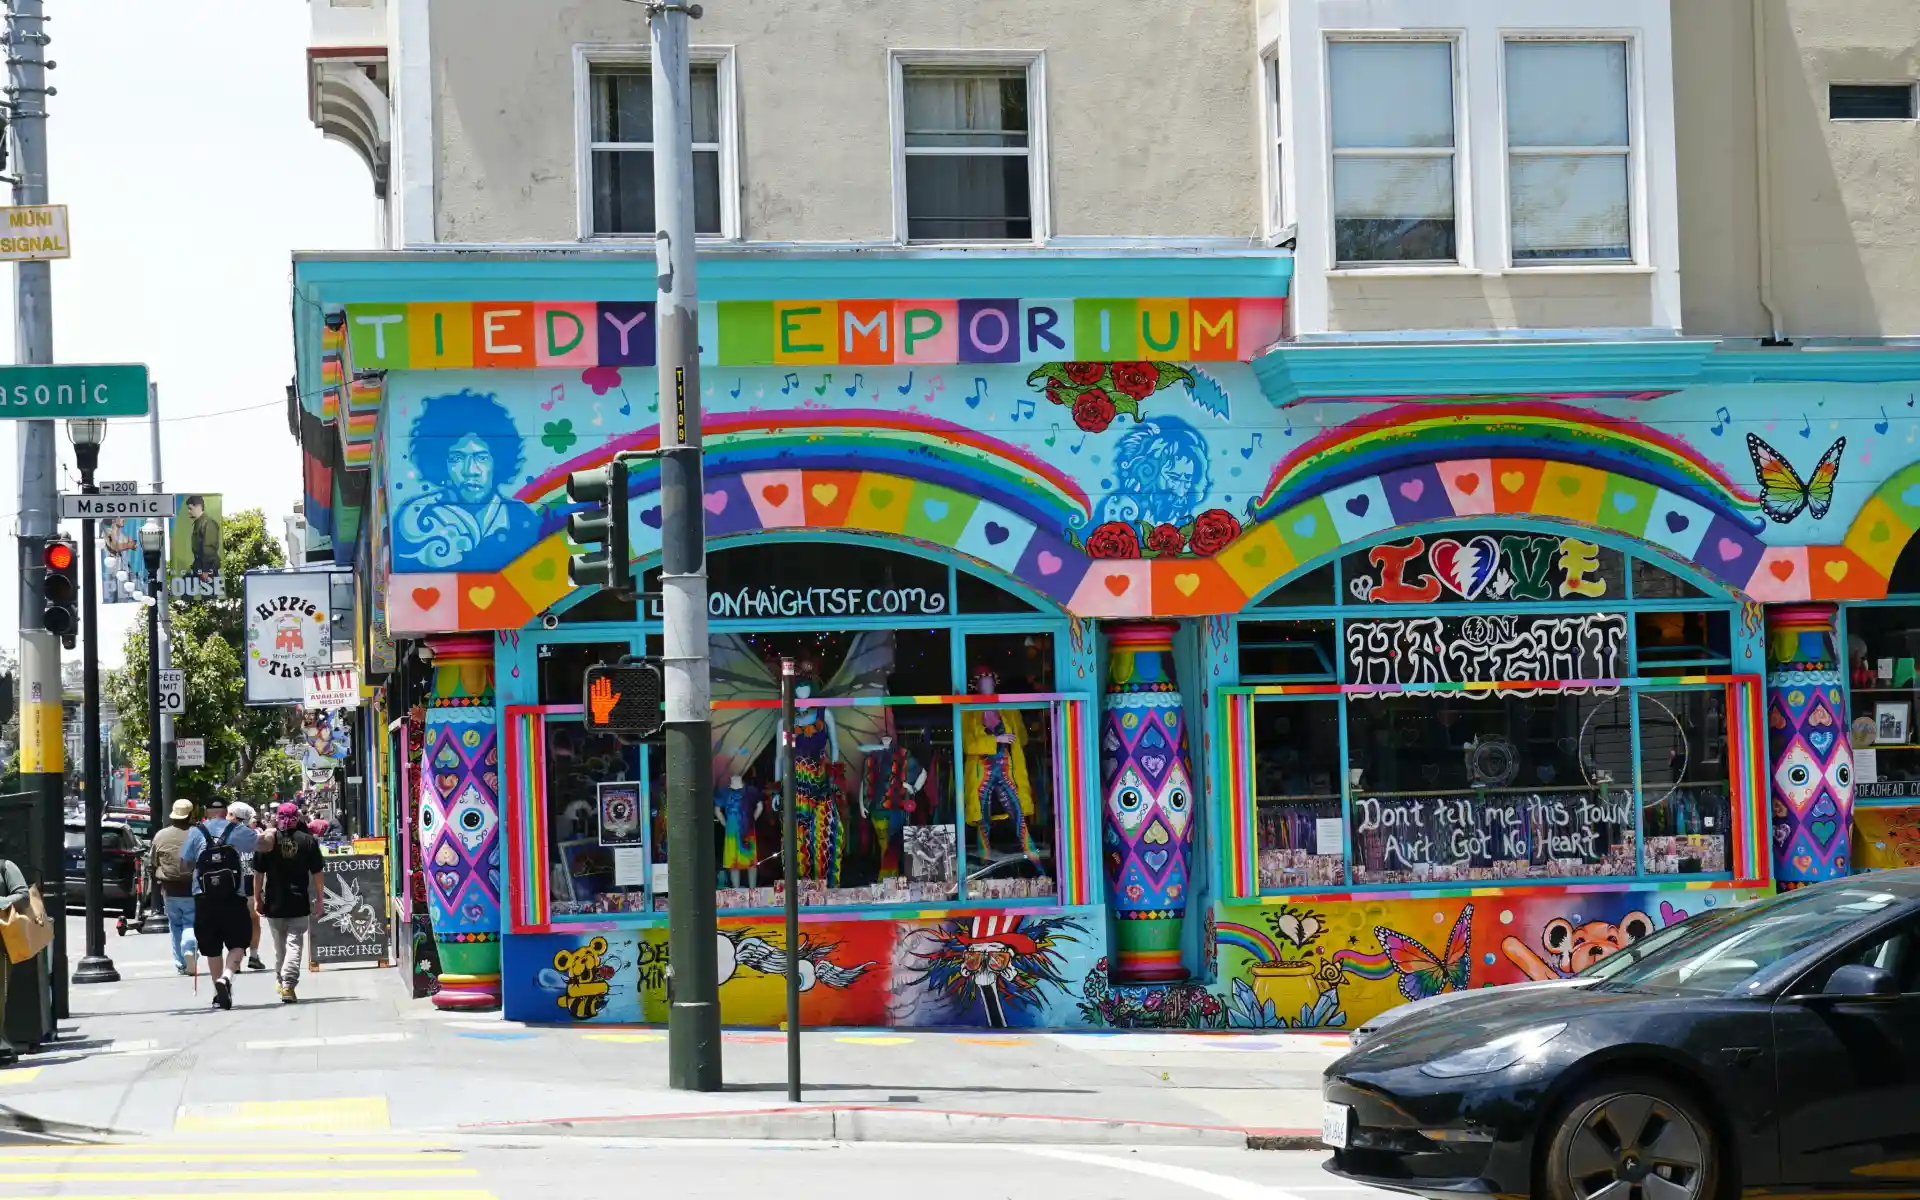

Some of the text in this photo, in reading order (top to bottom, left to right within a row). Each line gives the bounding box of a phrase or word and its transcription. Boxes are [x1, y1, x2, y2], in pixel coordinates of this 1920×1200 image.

[9, 211, 53, 227] MUNI
[0, 236, 63, 252] SIGNAL
[356, 306, 1233, 358] TIEDY EMPORIUM
[111, 482, 135, 493] 1200
[78, 499, 158, 513] Masonic
[159, 693, 181, 709] 20
[1859, 783, 1904, 797] DEADHEAD
[1356, 798, 1424, 833] Don't
[1434, 798, 1475, 827] tell
[1485, 806, 1522, 828] me
[1527, 794, 1570, 826] this
[1451, 828, 1492, 865] Got
[1503, 830, 1527, 857] No
[322, 859, 380, 873] TTOOING
[317, 944, 383, 957] PIERCING
[637, 940, 669, 966] BE
